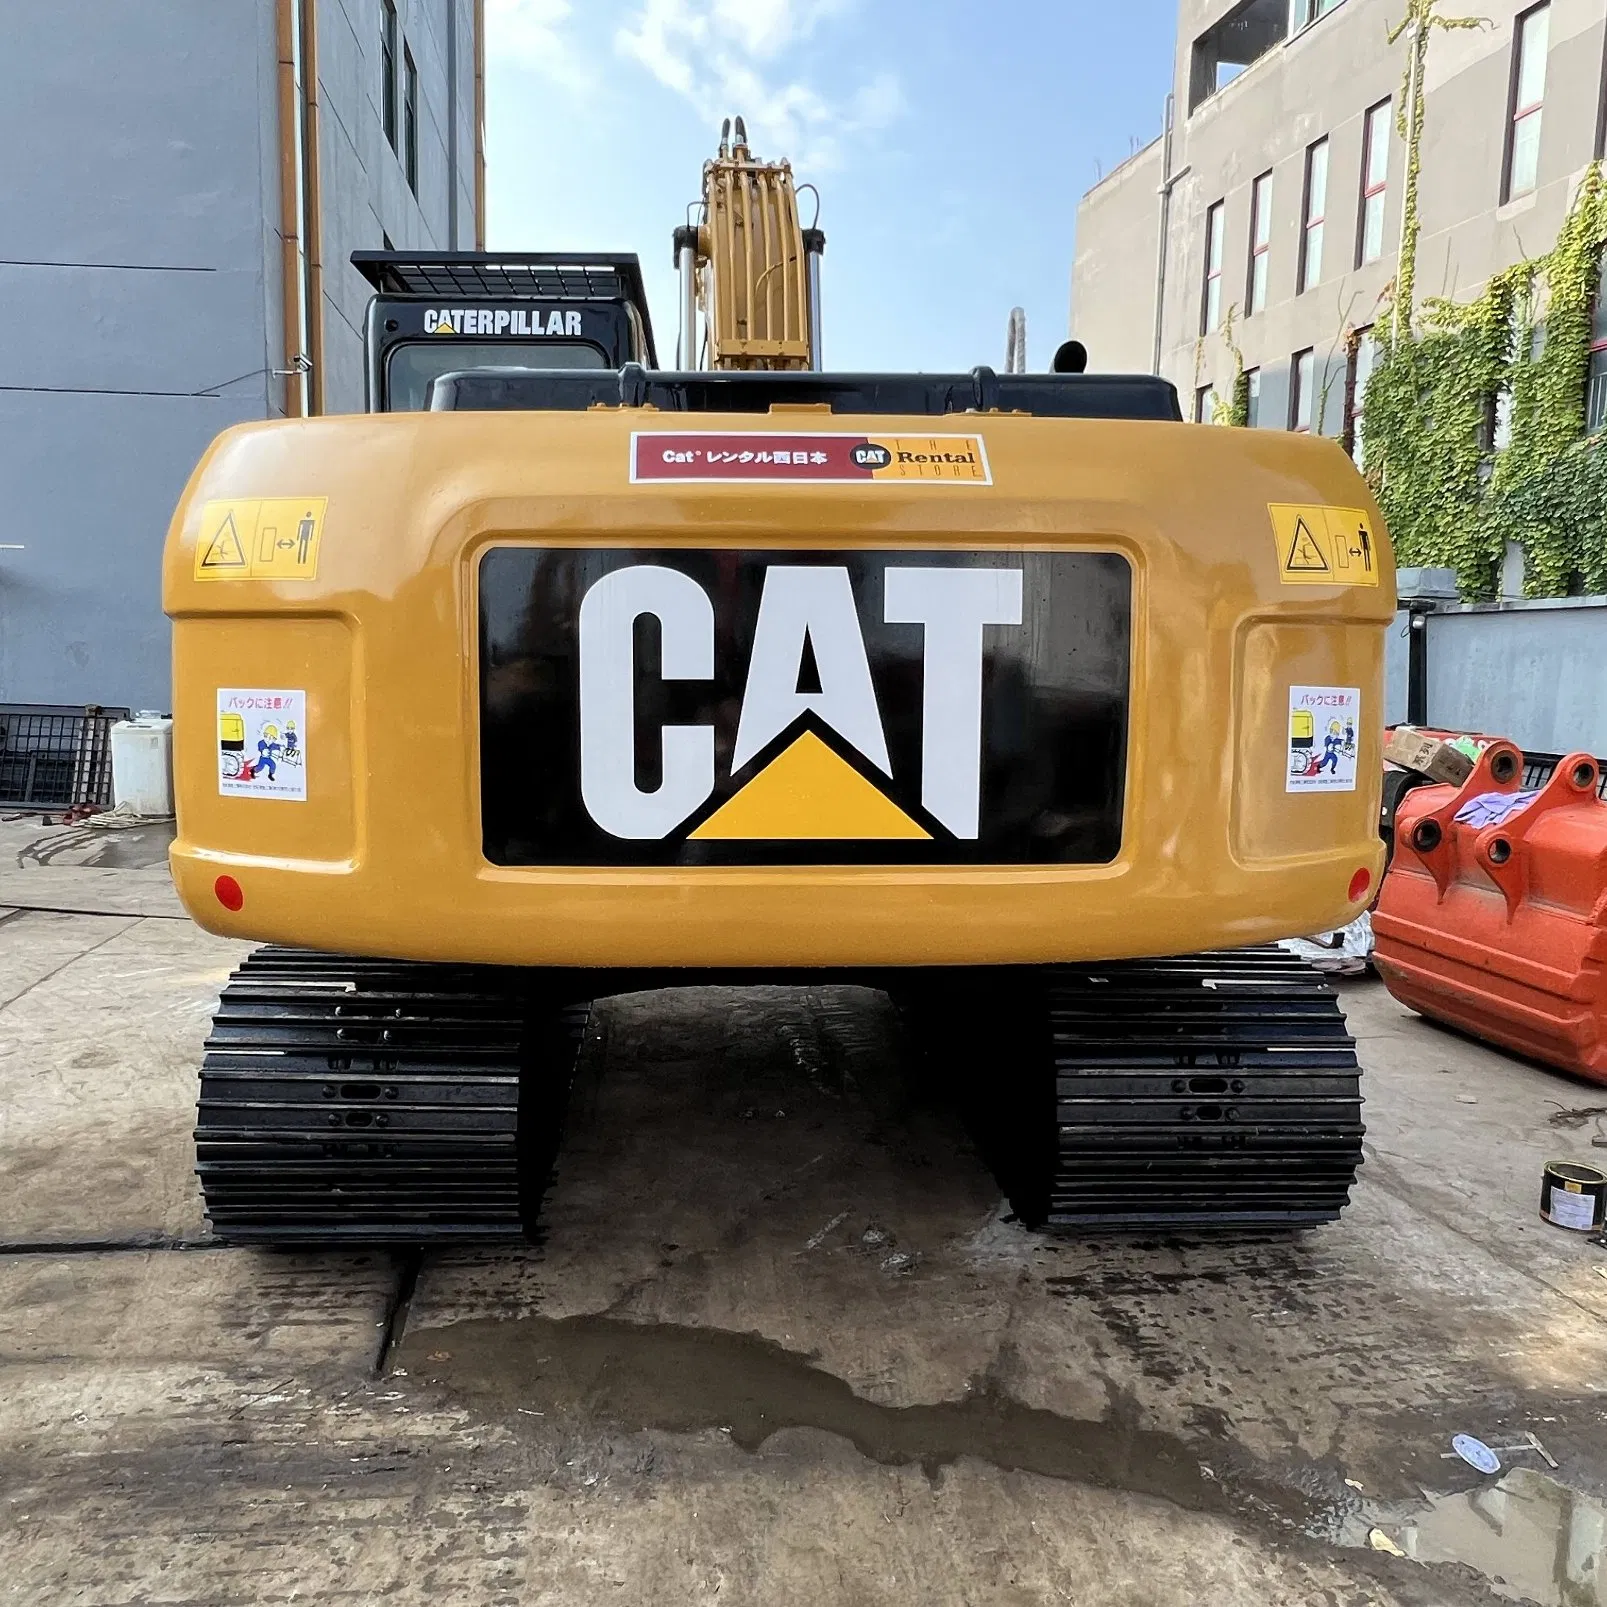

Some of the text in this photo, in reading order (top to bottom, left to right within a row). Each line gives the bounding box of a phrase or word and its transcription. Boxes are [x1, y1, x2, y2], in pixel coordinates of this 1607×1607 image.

[424, 309, 582, 336] CATERPILLAR
[895, 439, 973, 450] THE
[706, 451, 828, 465] レンタル西日本
[855, 449, 885, 464] CAT
[896, 451, 976, 464] Rental
[899, 464, 978, 477] STORE
[579, 565, 1024, 840] CAT
